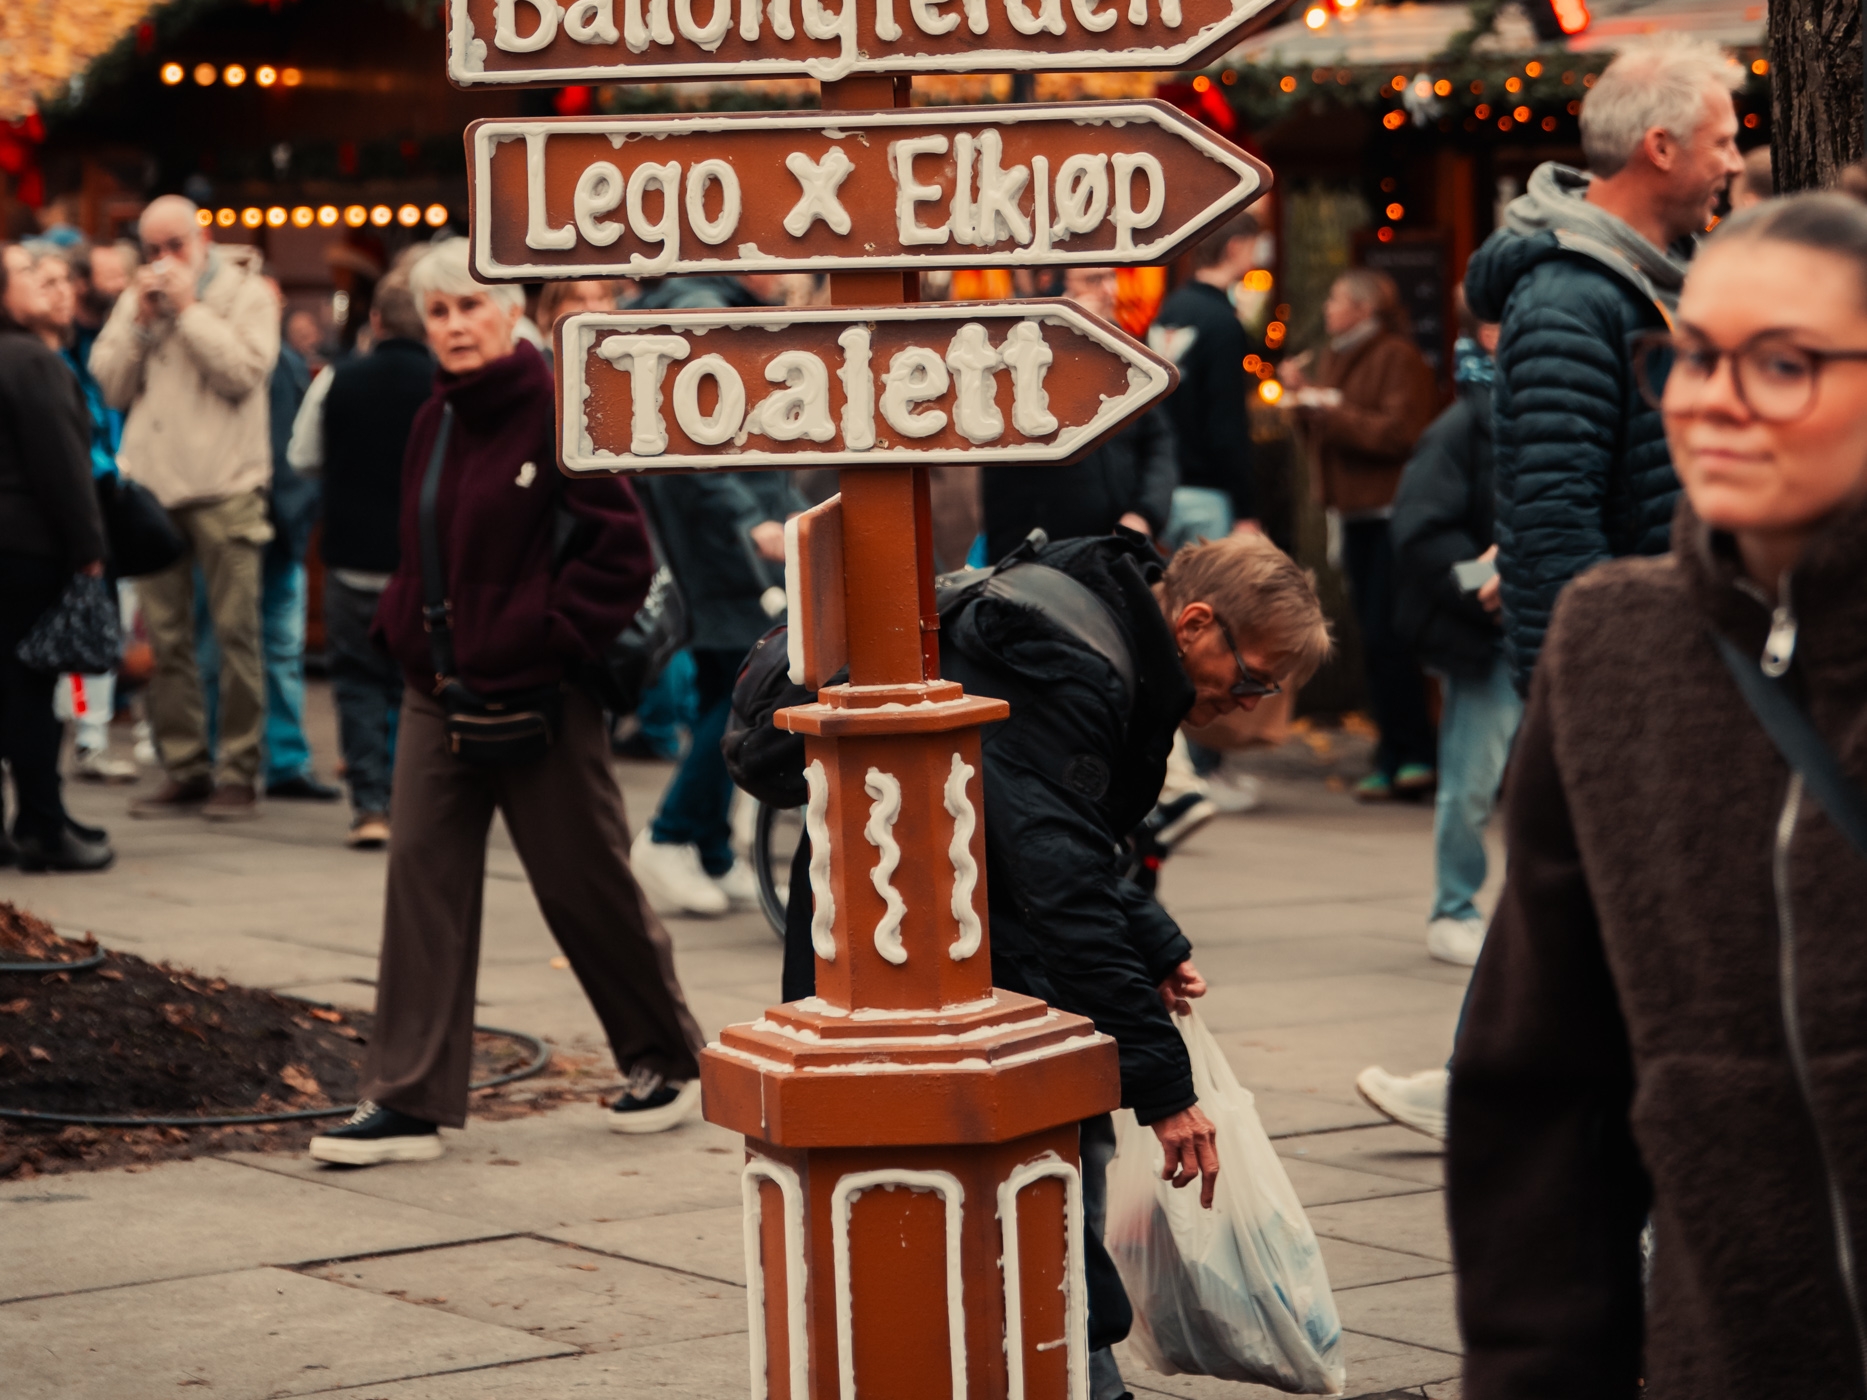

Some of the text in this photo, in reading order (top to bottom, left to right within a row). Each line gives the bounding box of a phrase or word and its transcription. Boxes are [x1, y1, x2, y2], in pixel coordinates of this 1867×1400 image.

[524, 130, 742, 276] Lego
[888, 127, 1166, 253] Elkjøp
[598, 321, 1059, 457] Toalett
